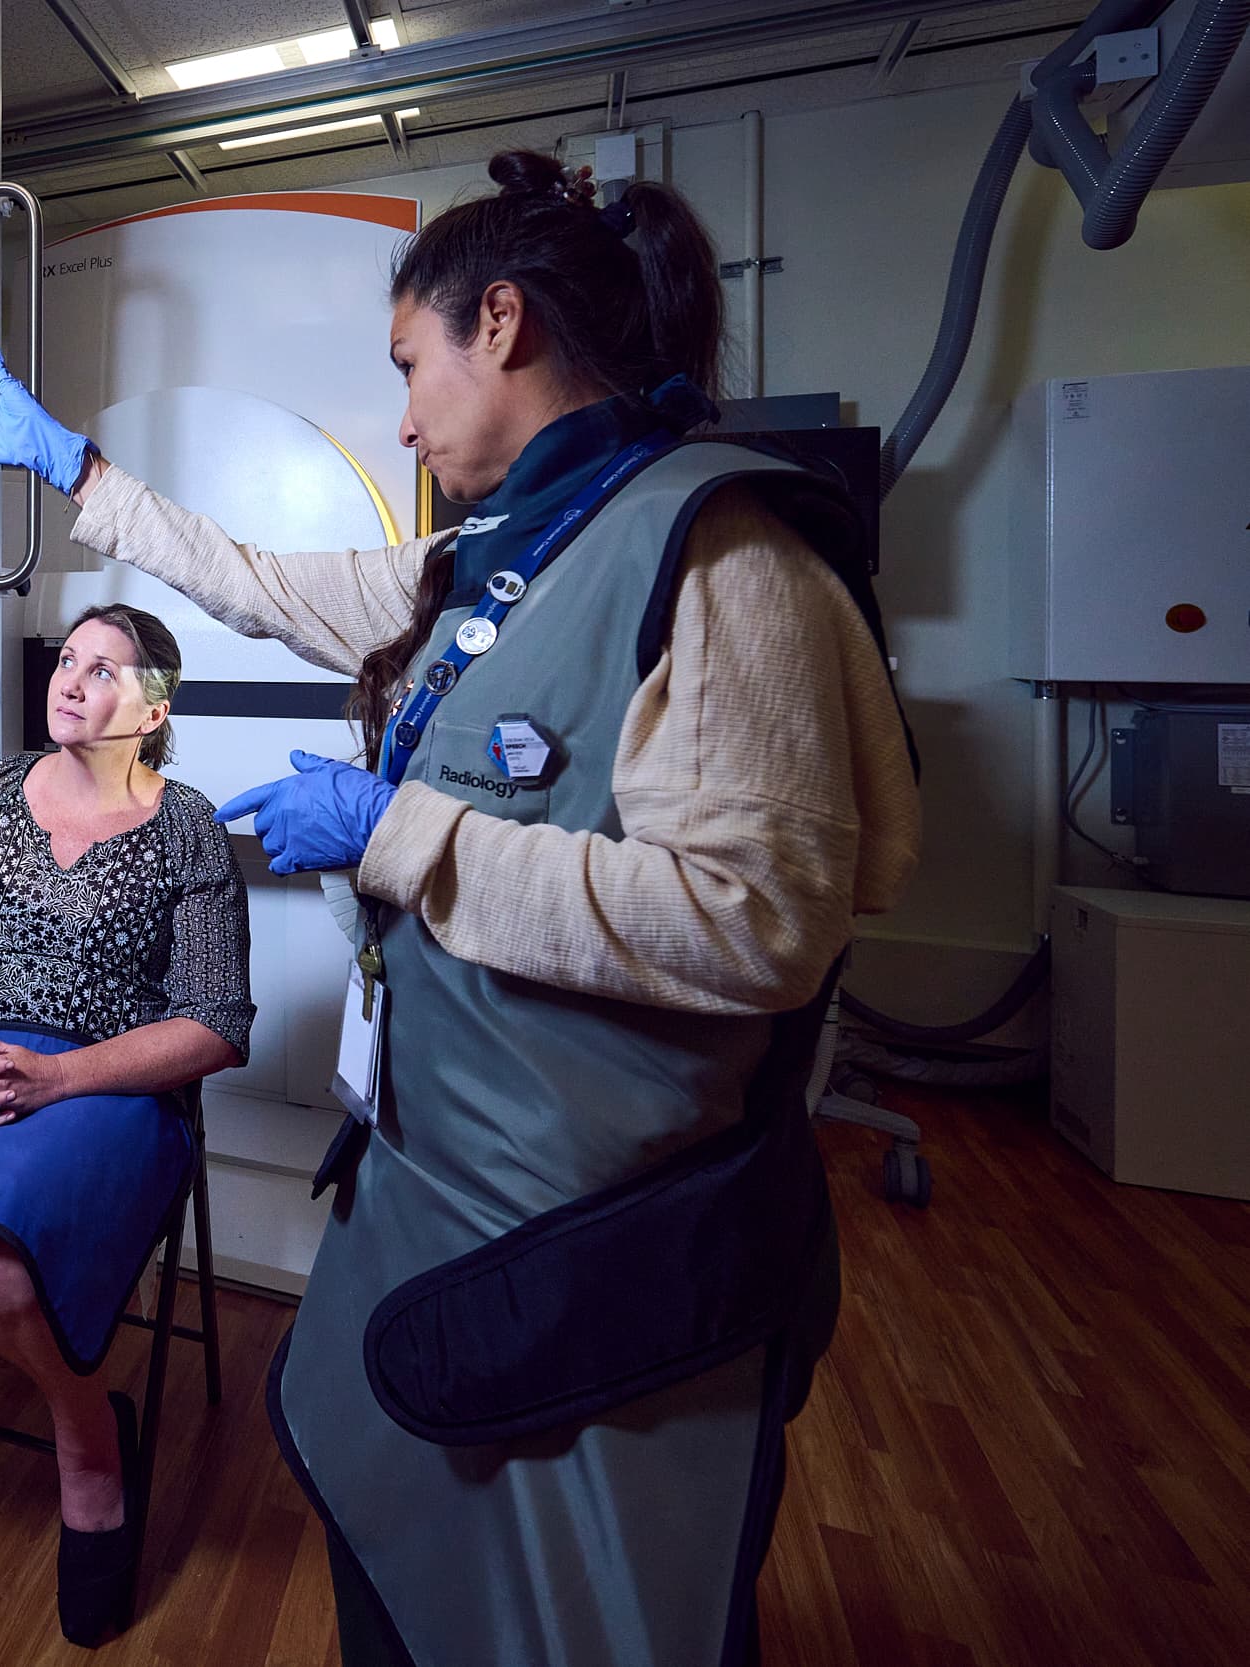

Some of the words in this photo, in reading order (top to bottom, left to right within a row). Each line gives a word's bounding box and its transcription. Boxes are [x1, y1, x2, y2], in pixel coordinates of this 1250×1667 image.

[60, 258, 87, 275] Excel
[90, 255, 112, 271] Plus
[439, 765, 518, 799] Radiology
